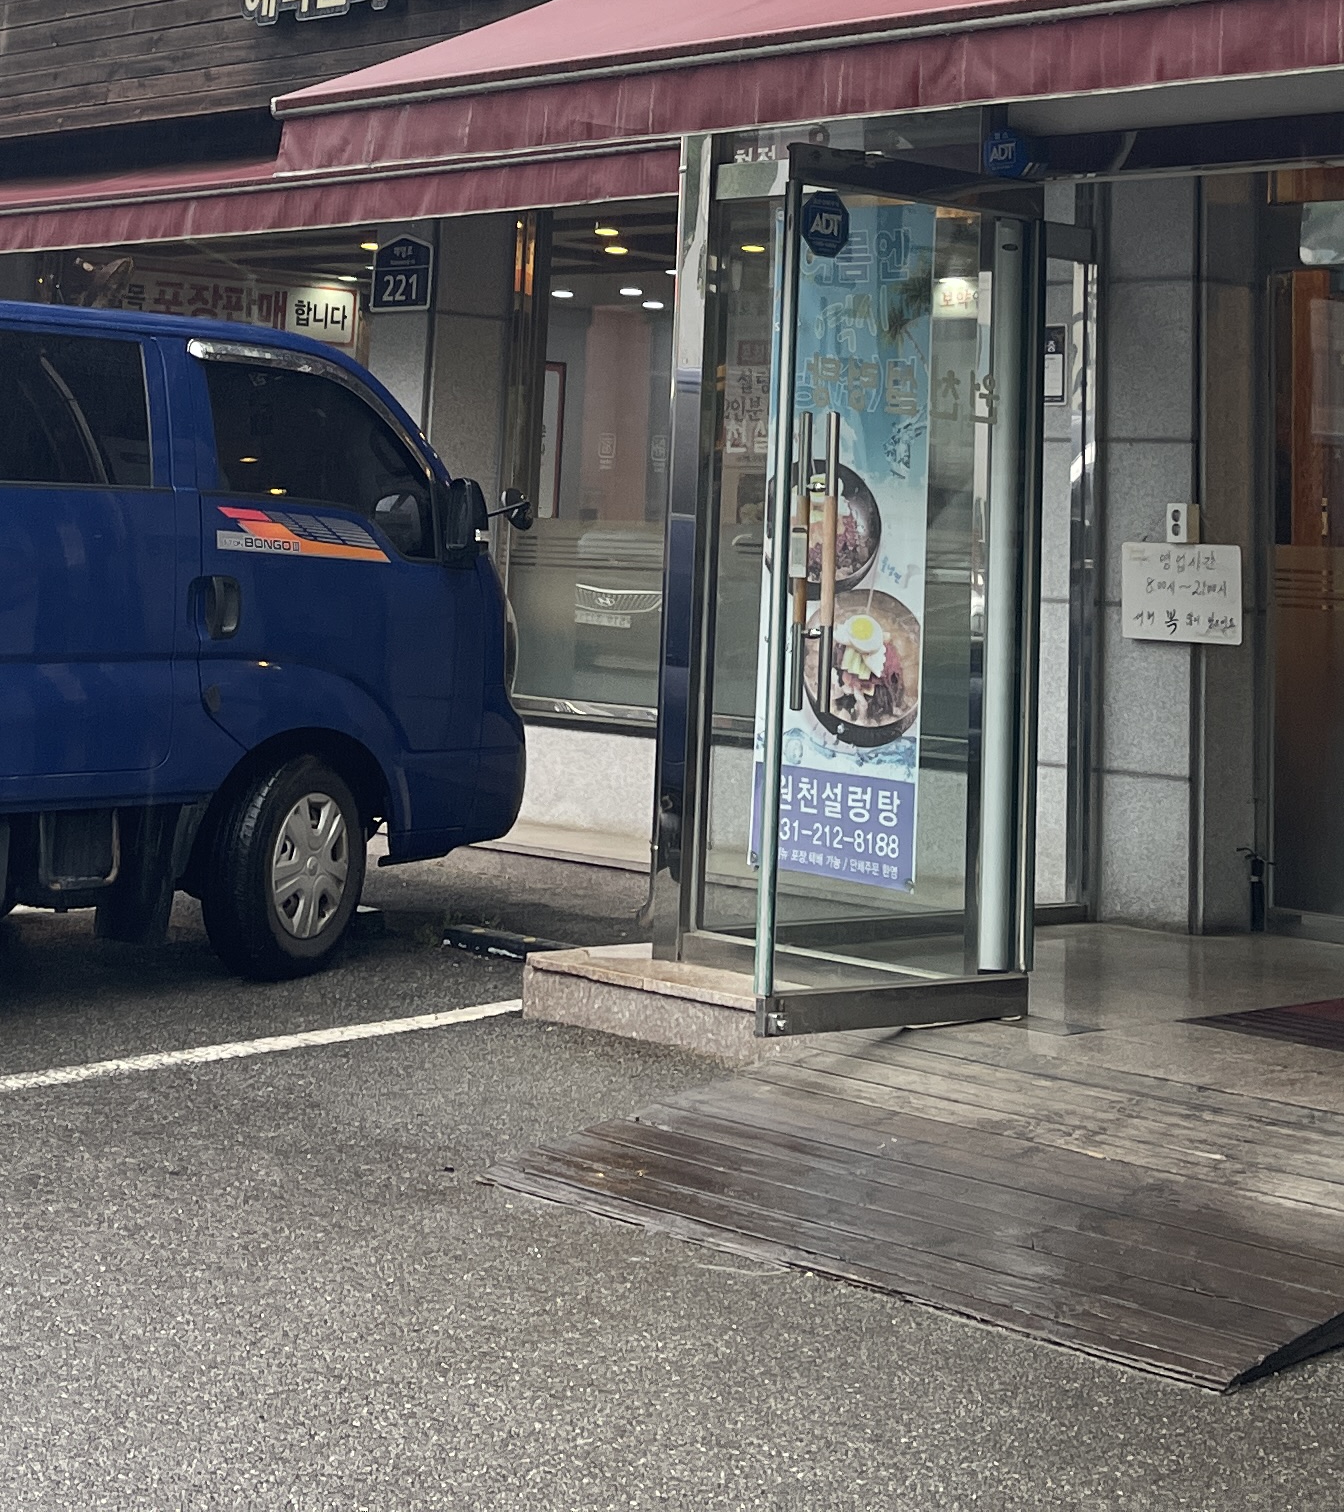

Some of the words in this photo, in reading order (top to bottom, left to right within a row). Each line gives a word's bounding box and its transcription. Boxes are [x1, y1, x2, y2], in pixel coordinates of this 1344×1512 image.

[989, 142, 1016, 162] ADT
[809, 212, 843, 237] ADT
[382, 274, 417, 301] 221
[150, 281, 288, 330] 포장판매
[294, 299, 347, 331] 합니다
[244, 537, 291, 550] BONGO
[1159, 550, 1216, 573] 영업시간
[779, 817, 899, 858] 31-212-8188
[826, 855, 841, 870] 가능
